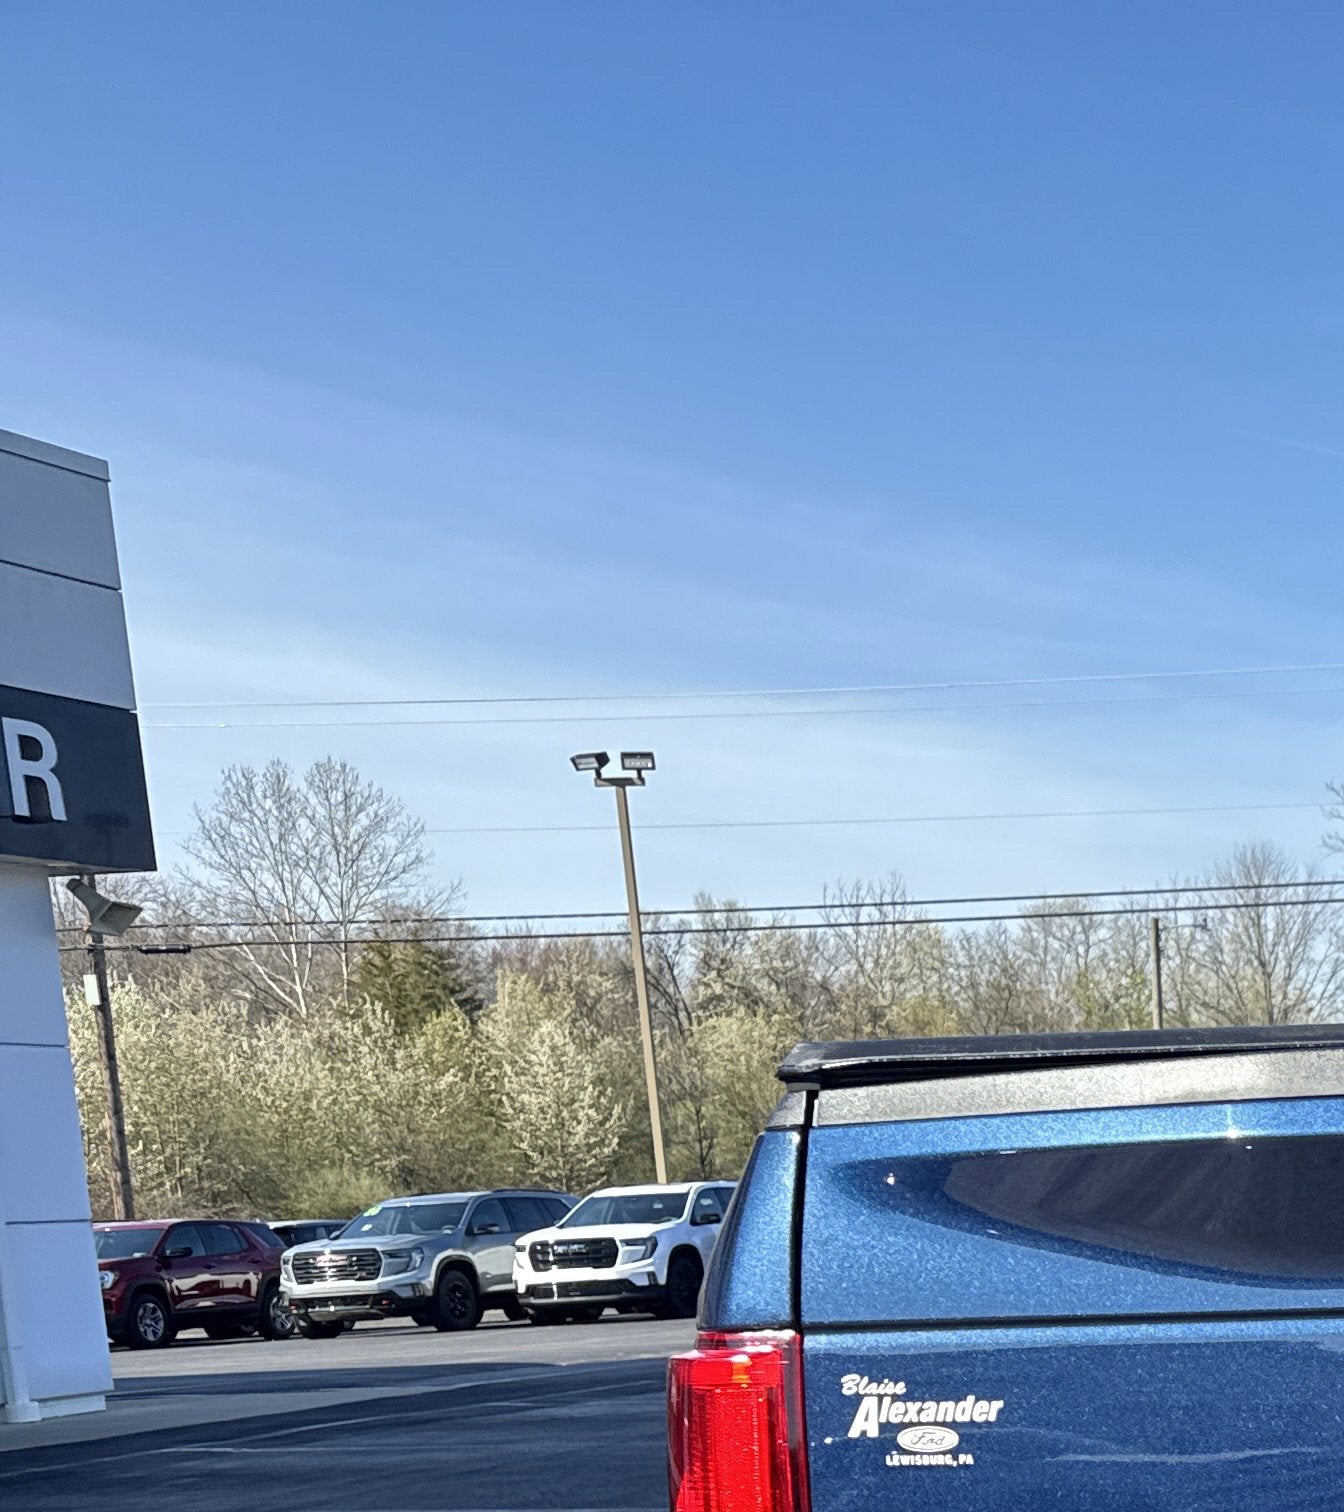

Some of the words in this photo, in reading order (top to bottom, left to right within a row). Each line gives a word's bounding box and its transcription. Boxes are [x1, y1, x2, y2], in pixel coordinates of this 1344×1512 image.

[2, 716, 68, 822] R
[840, 1373, 907, 1396] Blaise
[847, 1394, 1004, 1438] Alexander
[910, 1431, 946, 1446] Ford
[958, 1453, 975, 1466] PA
